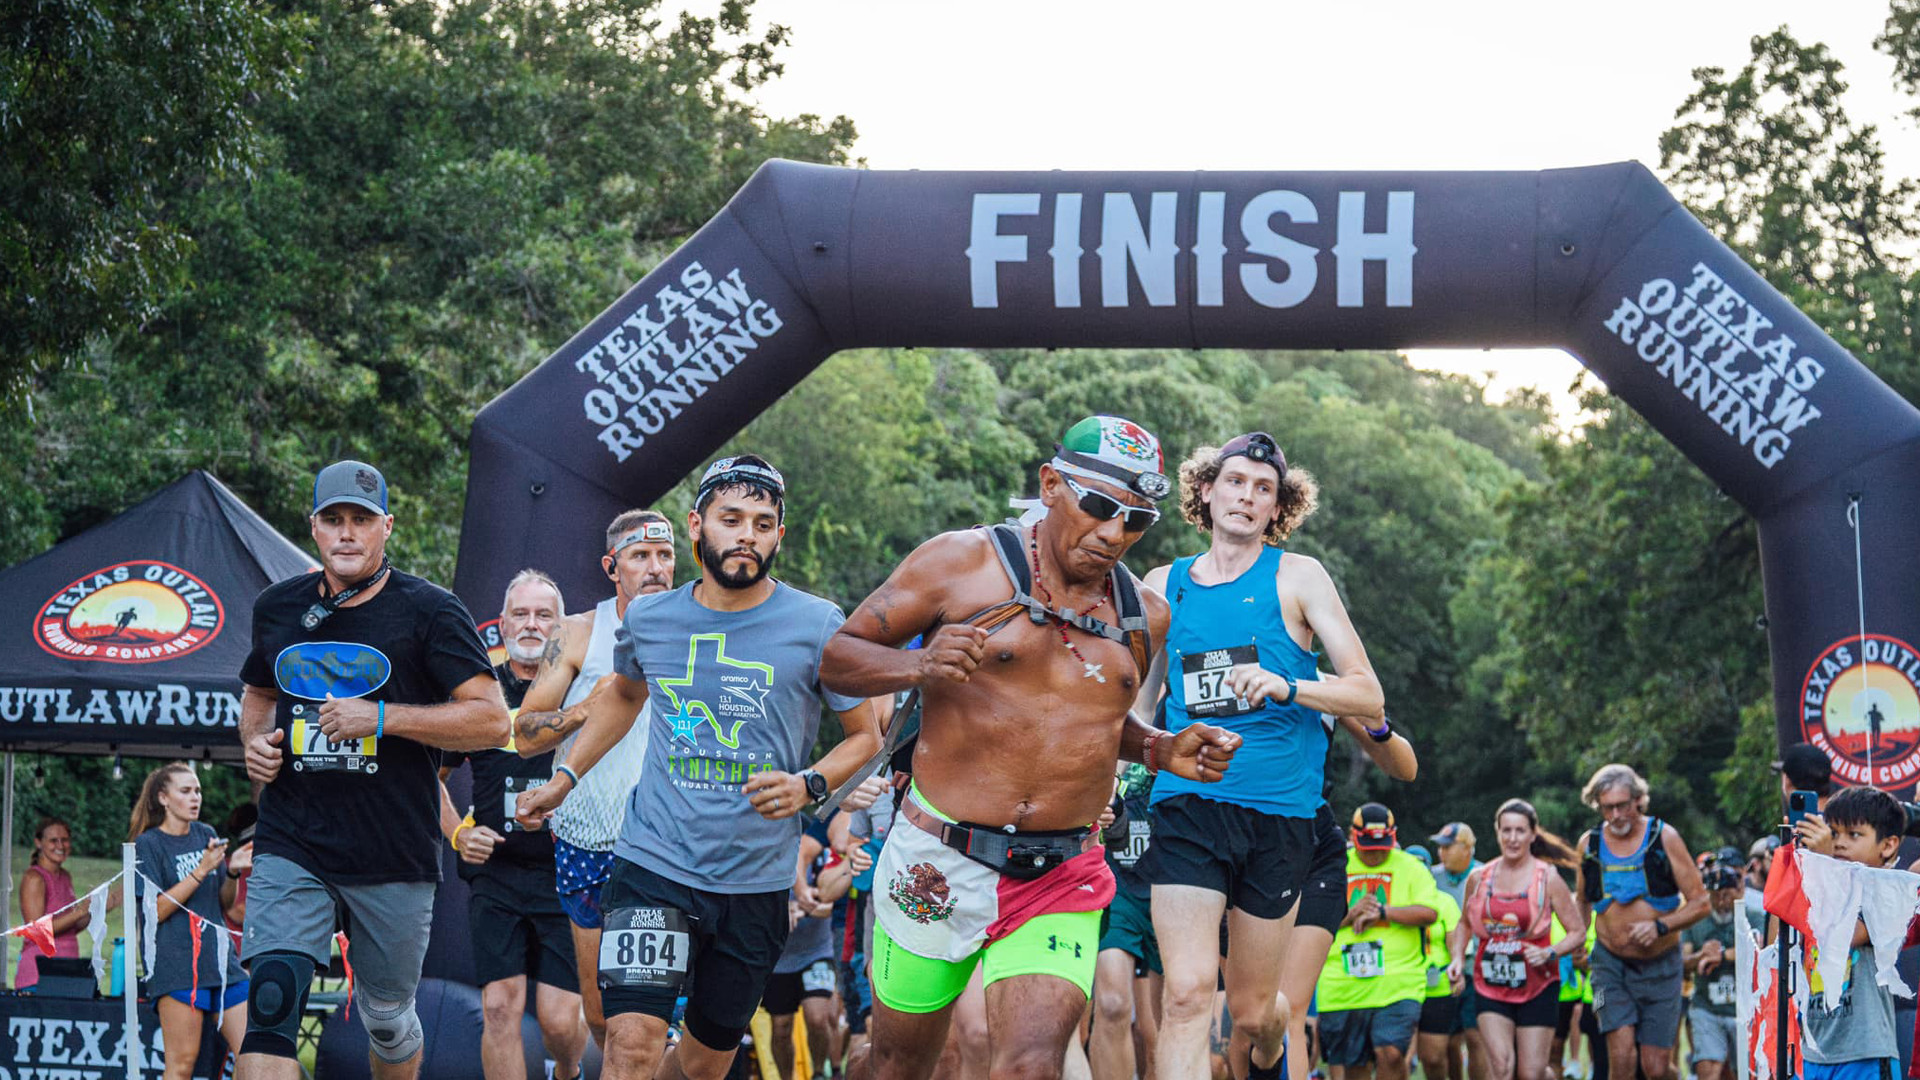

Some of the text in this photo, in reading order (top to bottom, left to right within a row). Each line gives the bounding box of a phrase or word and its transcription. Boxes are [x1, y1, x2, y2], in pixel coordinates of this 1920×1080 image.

[965, 190, 1418, 308] FINISH
[575, 261, 713, 382] TEXAS
[584, 268, 752, 425] OUTLAW
[1684, 262, 1825, 391] TEXAS
[597, 299, 784, 463] RUNNING
[1603, 297, 1791, 469] RUNNING
[1639, 279, 1822, 434] OUTLAW
[45, 565, 217, 628] TEXAS OUTLAW
[43, 622, 198, 659] RUNNING COMPANY
[719, 704, 755, 712] HOUSTON
[720, 675, 749, 683] aramco
[1804, 645, 1853, 721] TEXAS
[670, 745, 772, 760] HOUSTON
[678, 720, 691, 730] 13.1
[632, 914, 665, 922] OUTLAW
[635, 909, 662, 917] TEXAS
[617, 932, 676, 967] 864
